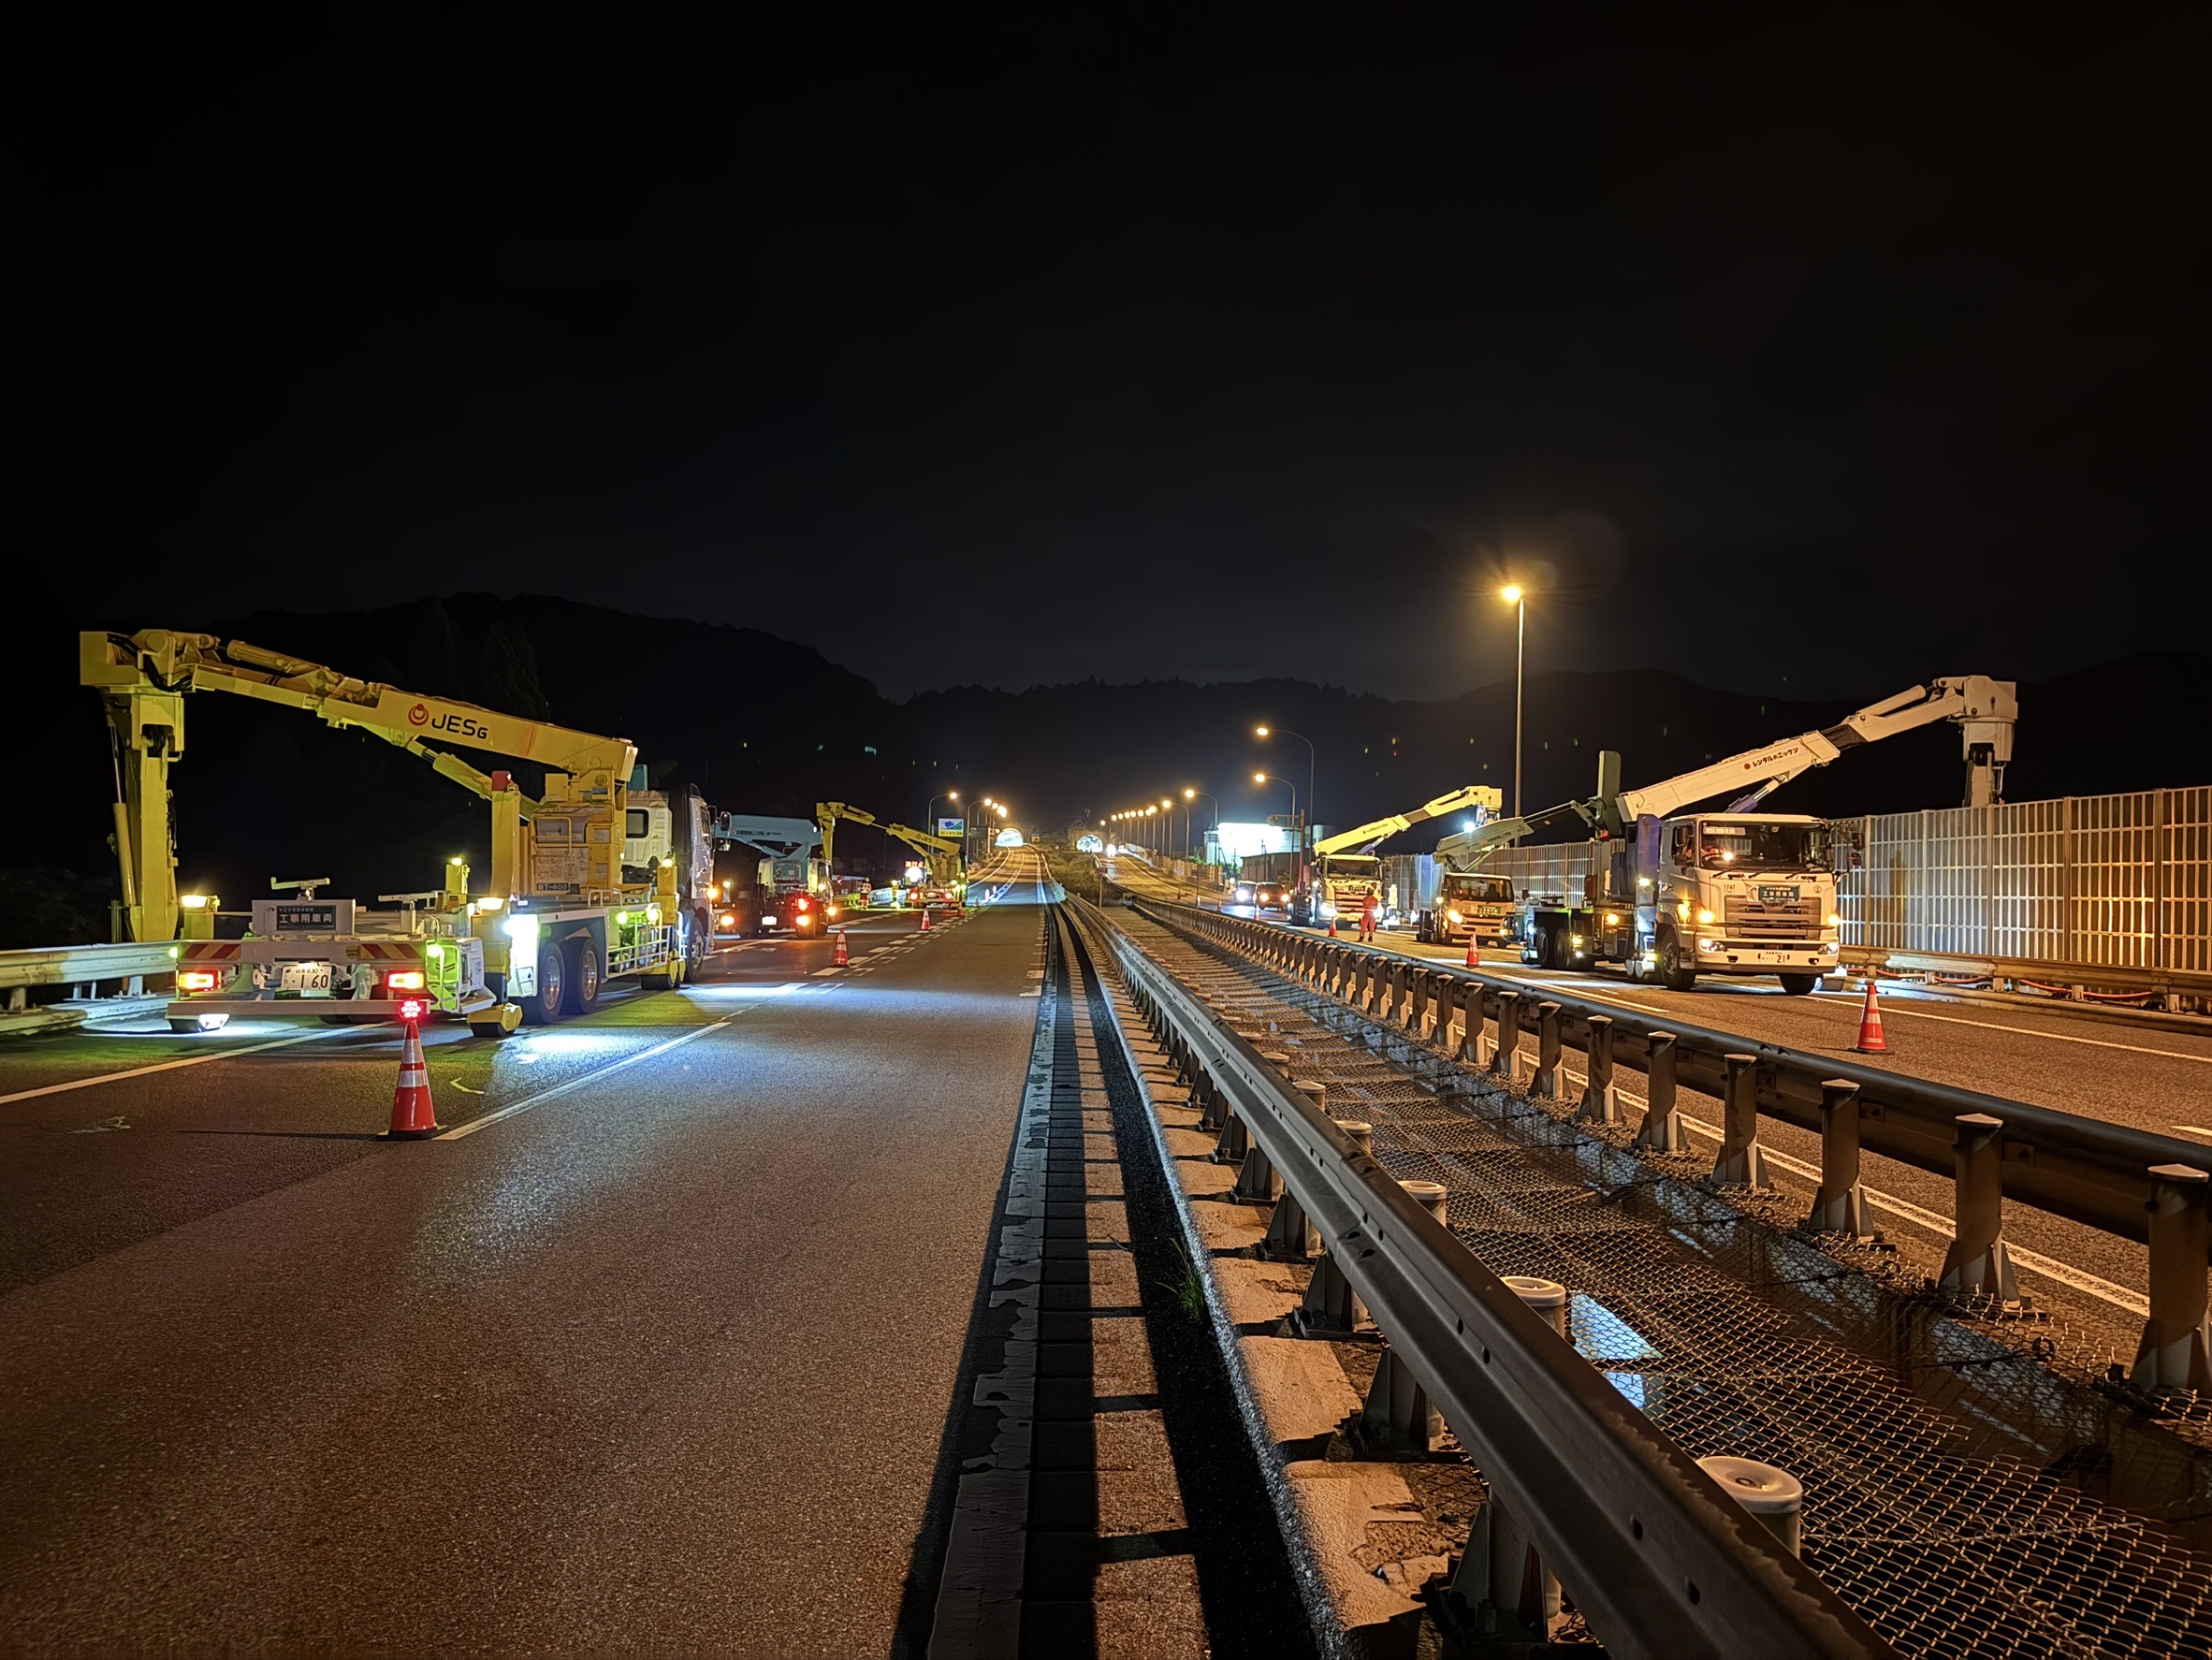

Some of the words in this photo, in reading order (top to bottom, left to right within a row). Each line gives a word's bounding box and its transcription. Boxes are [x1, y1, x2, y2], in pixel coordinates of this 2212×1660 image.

[1752, 747, 1798, 767] レンタルのニッケン
[279, 913, 332, 924] 工事用車両
